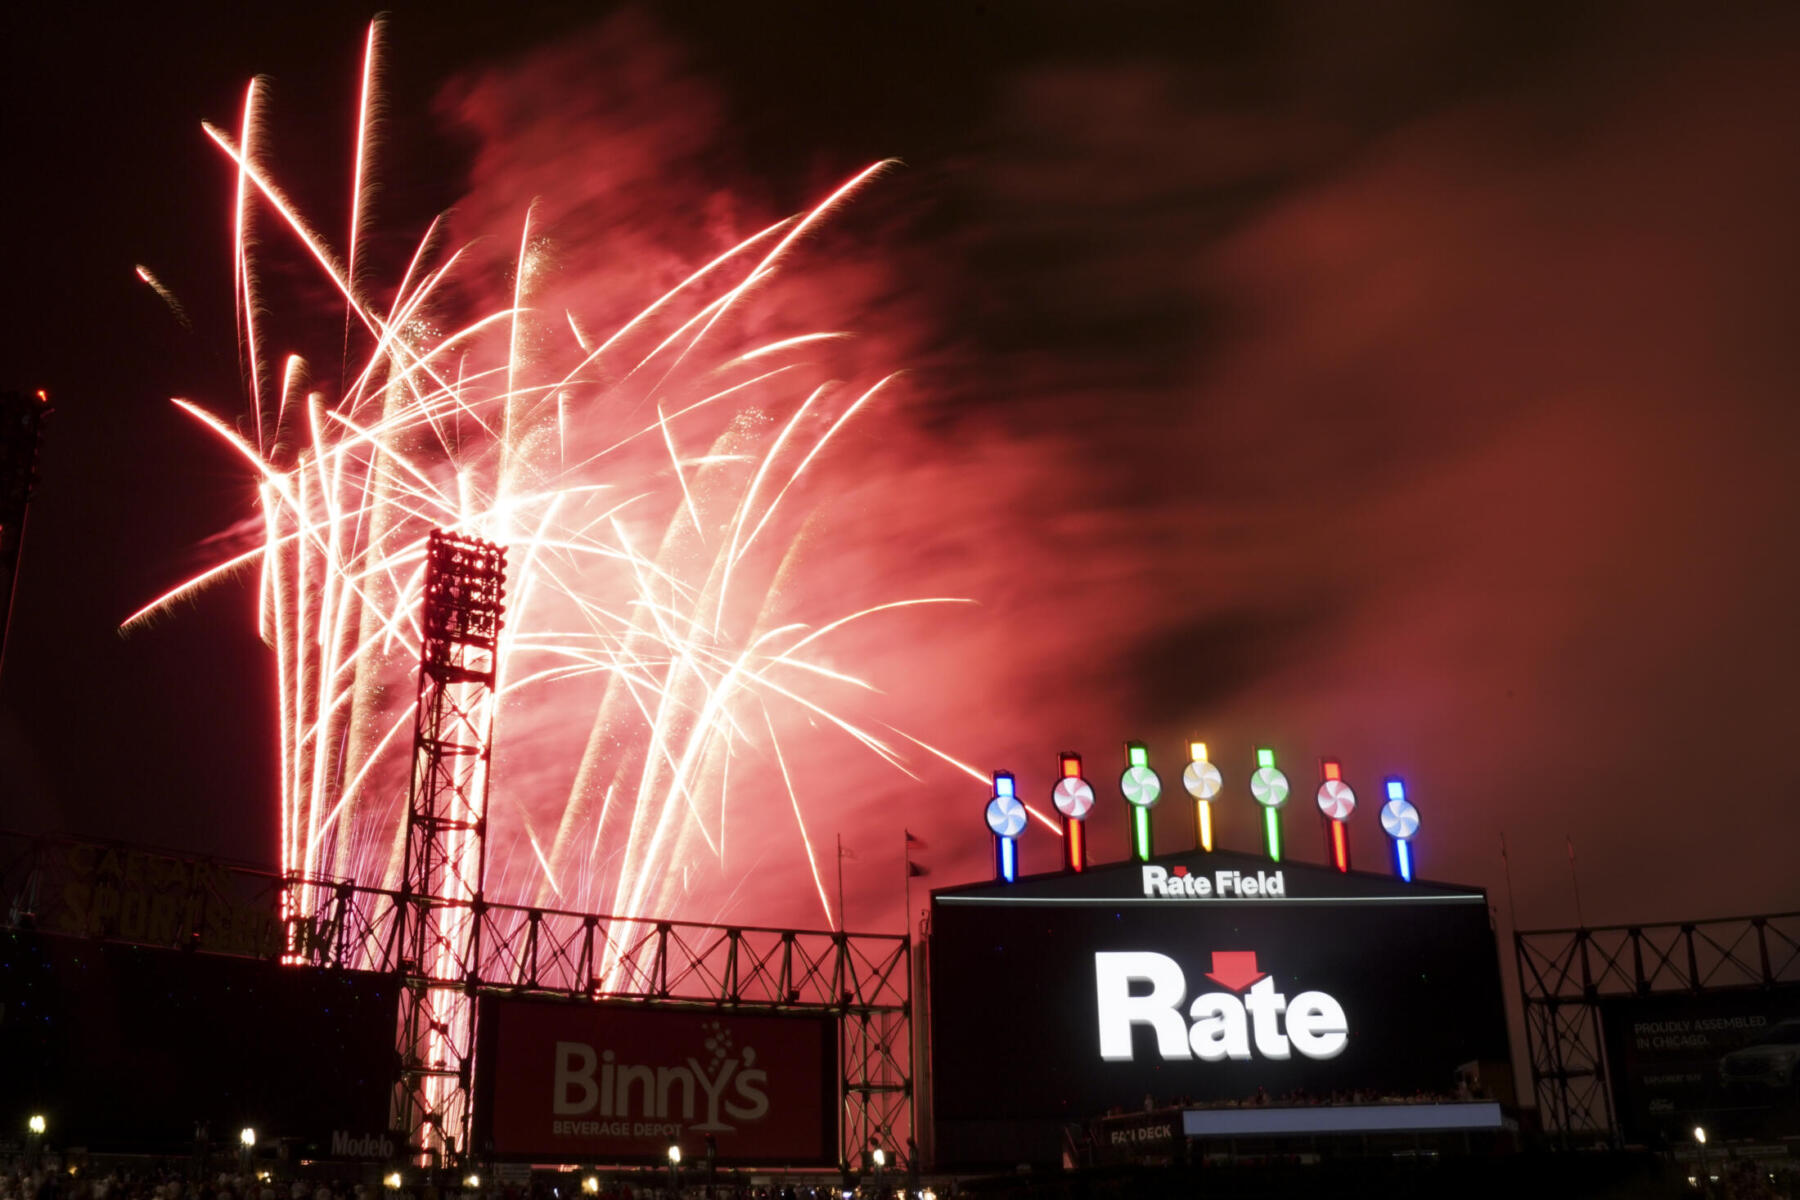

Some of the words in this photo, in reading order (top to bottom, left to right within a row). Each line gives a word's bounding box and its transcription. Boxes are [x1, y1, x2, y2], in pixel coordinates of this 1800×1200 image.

[68, 844, 235, 893] CAESARS
[1142, 865, 1212, 897] Rate
[1215, 870, 1286, 897] Field
[1095, 952, 1349, 1061] Rate
[1634, 1019, 1690, 1034] PROUDLY
[1694, 1015, 1767, 1032] ASSEMBLED
[1636, 1037, 1650, 1049] IN
[552, 1121, 630, 1136] BEVERAGE
[633, 1122, 683, 1137] DEPOT
[1138, 1124, 1172, 1141] DECK
[330, 1129, 393, 1159] Modelo
